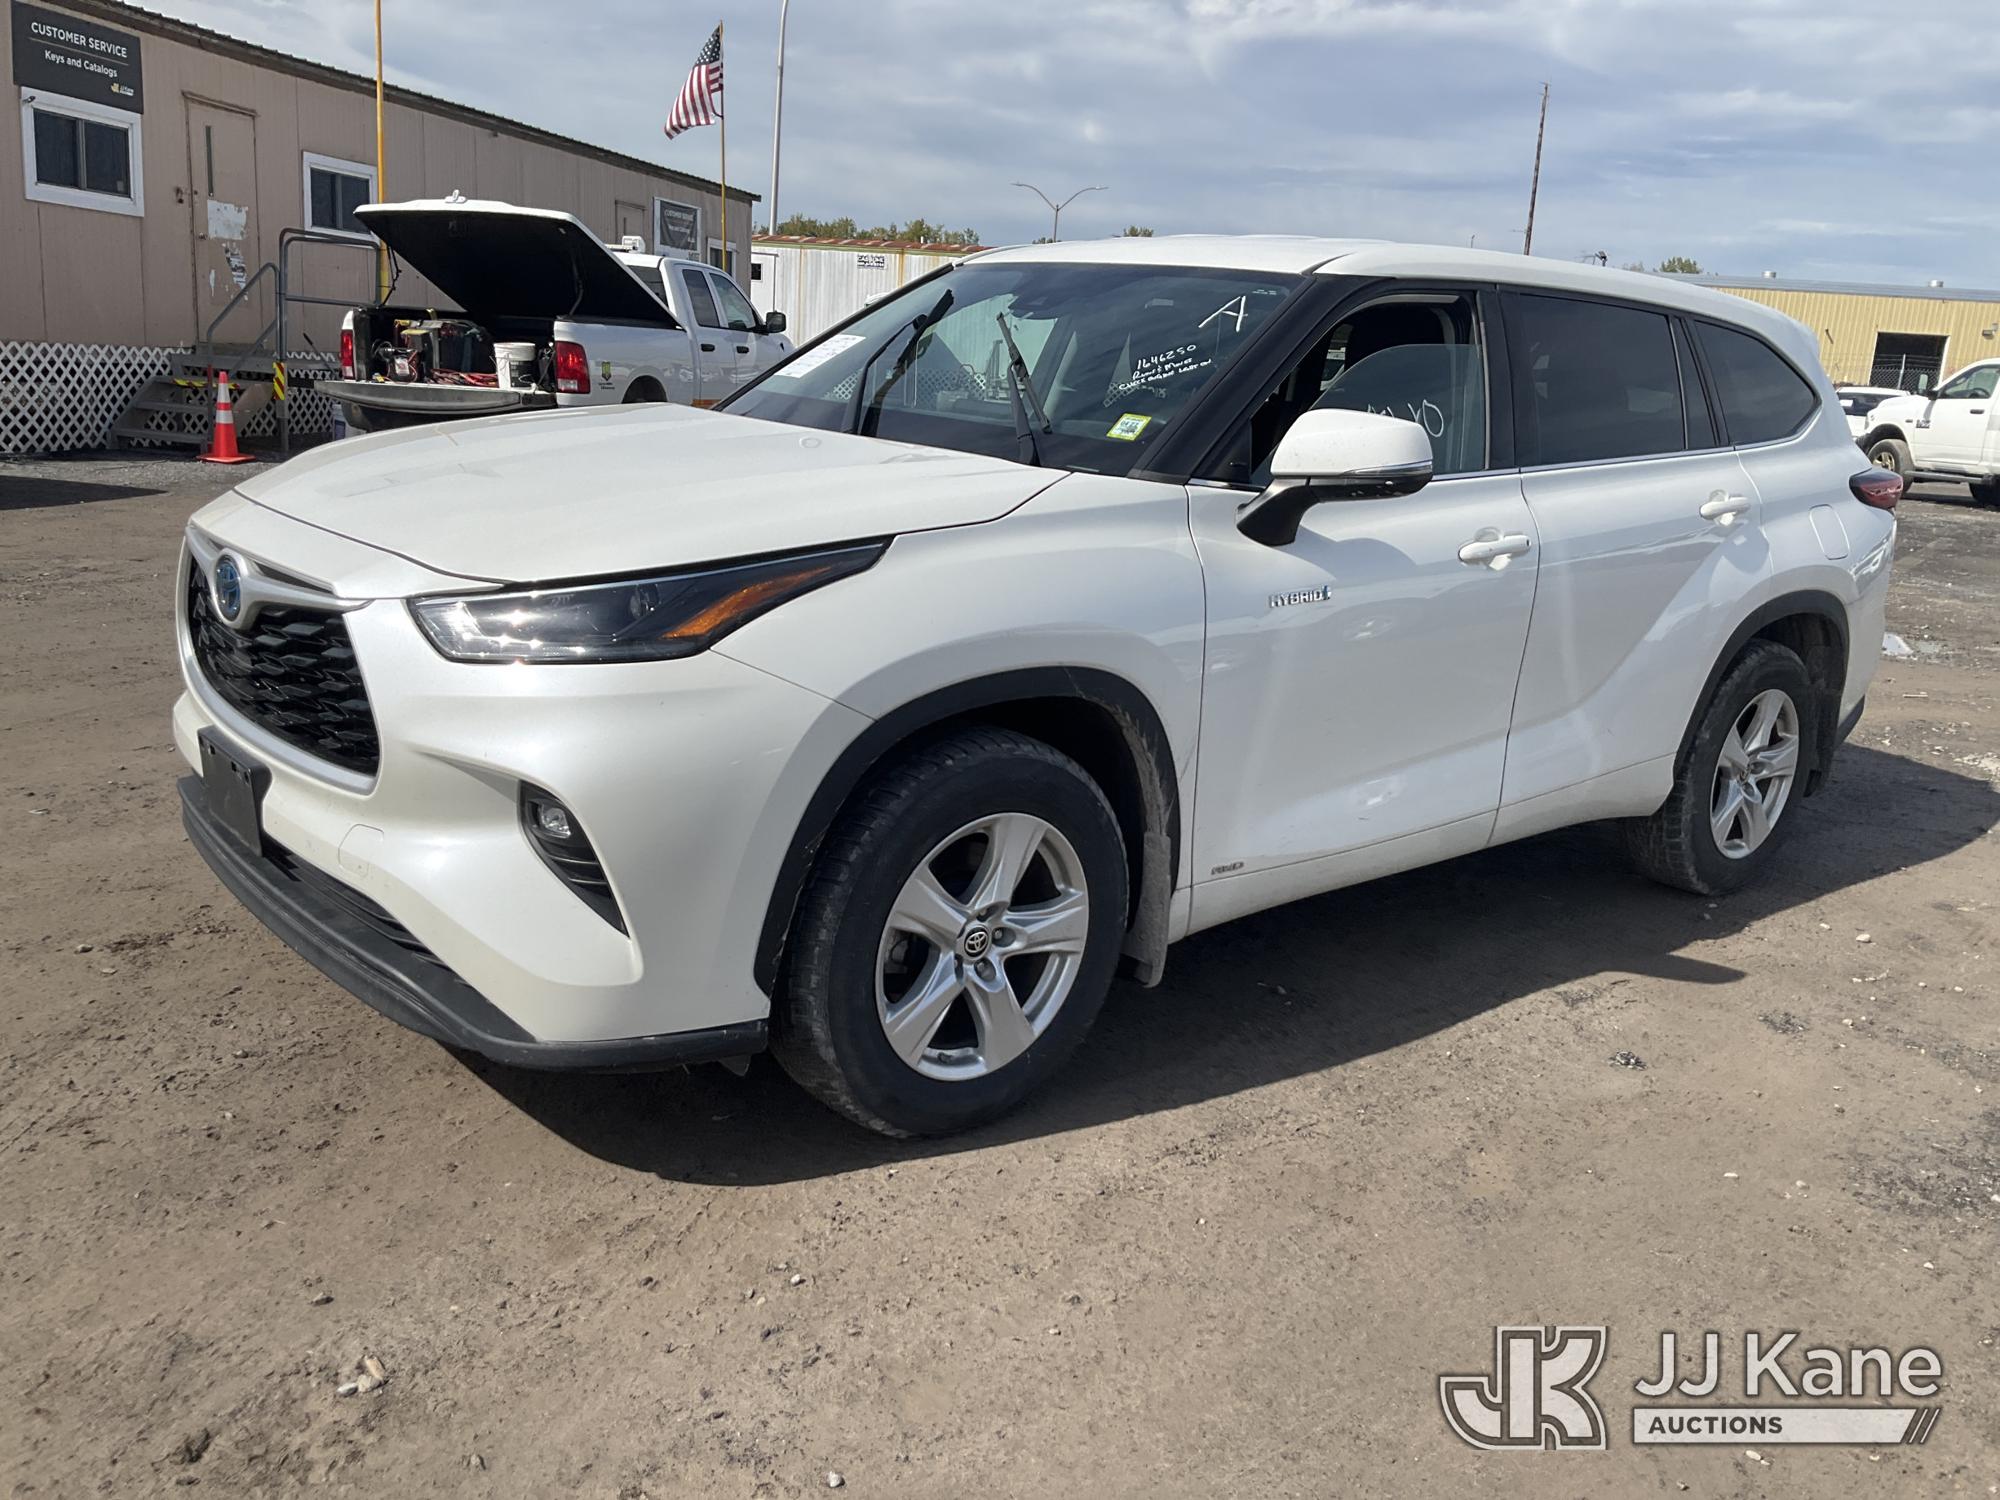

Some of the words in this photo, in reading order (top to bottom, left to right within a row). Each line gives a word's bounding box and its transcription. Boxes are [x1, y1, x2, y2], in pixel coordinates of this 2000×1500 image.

[31, 22, 87, 46] CUSTOMER
[88, 38, 128, 58] SERVICE
[44, 50, 65, 64] Keys
[66, 57, 82, 68] and
[83, 61, 118, 78] Catalogs
[1198, 295, 1249, 333] A
[1137, 344, 1197, 370] 1646250
[1268, 588, 1323, 608] HYBRID
